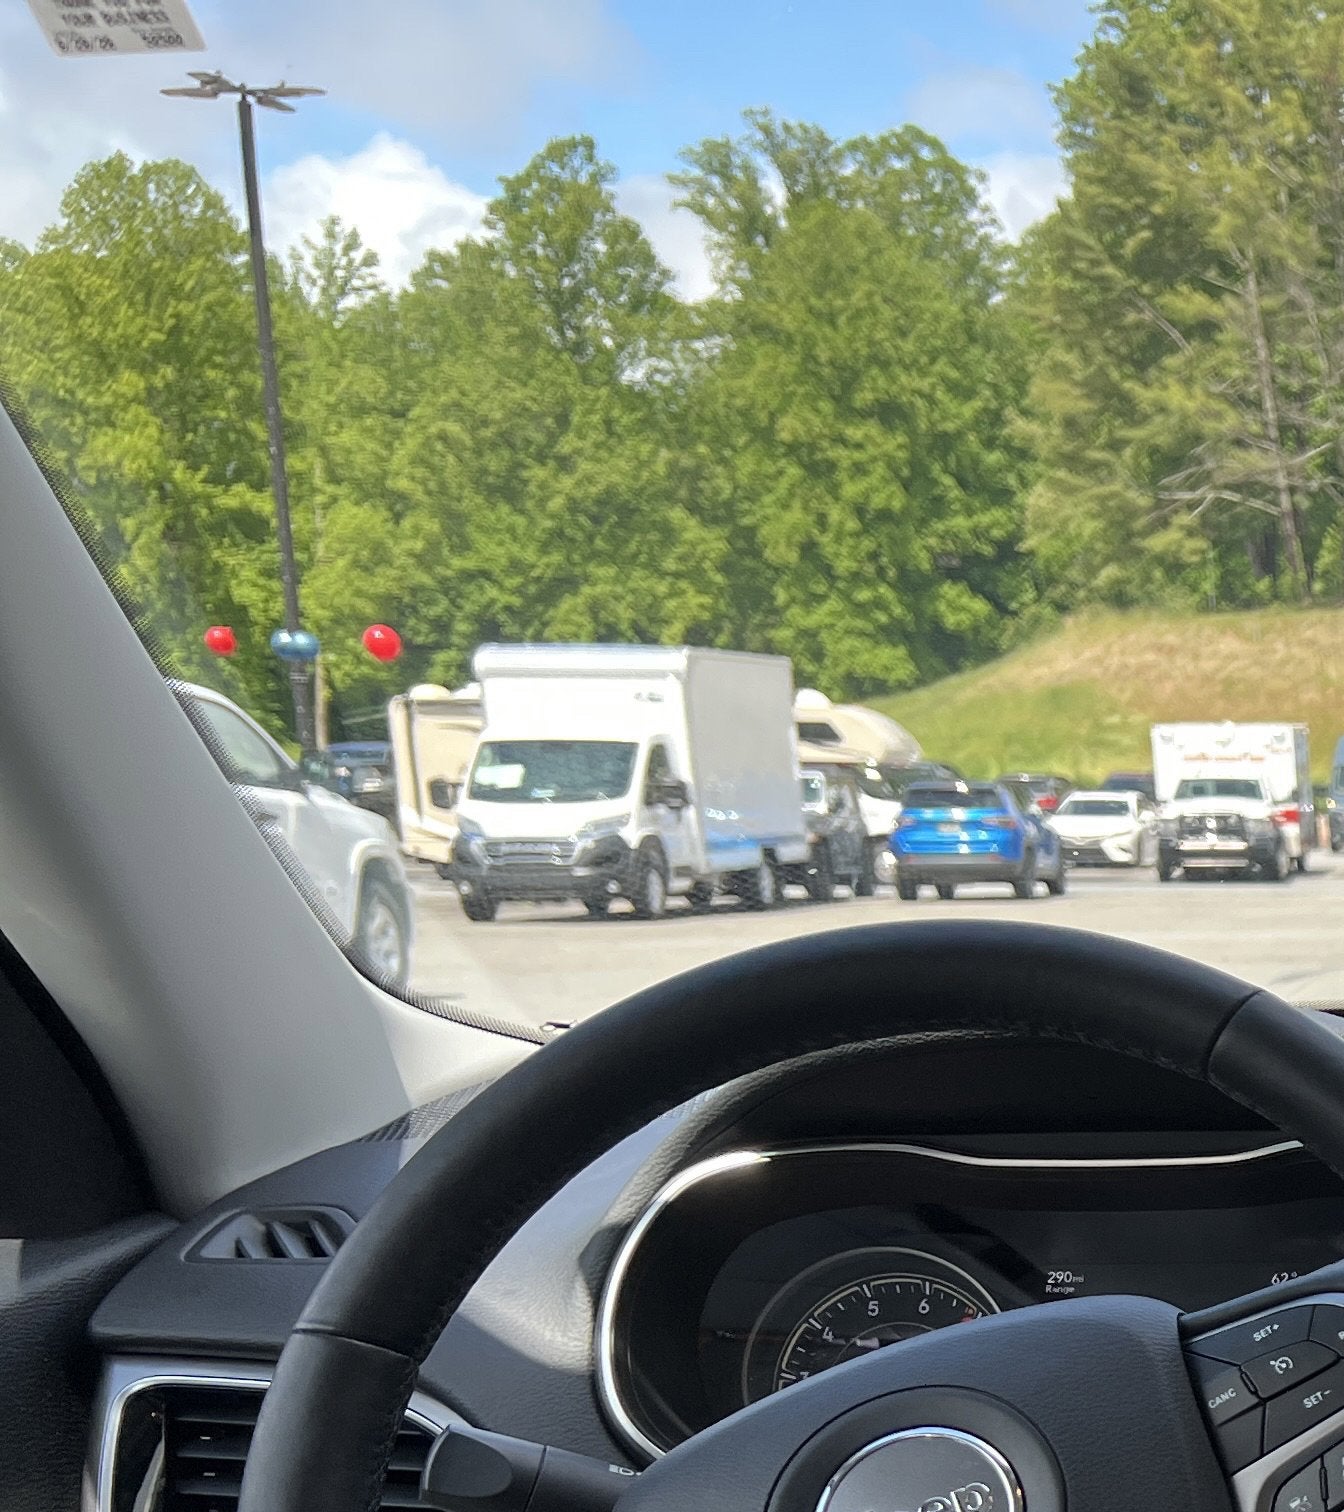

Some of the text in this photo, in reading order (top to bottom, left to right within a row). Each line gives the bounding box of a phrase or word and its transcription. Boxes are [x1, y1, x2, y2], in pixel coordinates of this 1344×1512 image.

[1046, 1285, 1075, 1294] Range
[868, 1301, 879, 1317] 5
[918, 1300, 930, 1315] 6
[822, 1327, 834, 1343] 4
[1208, 1387, 1237, 1409] CANC
